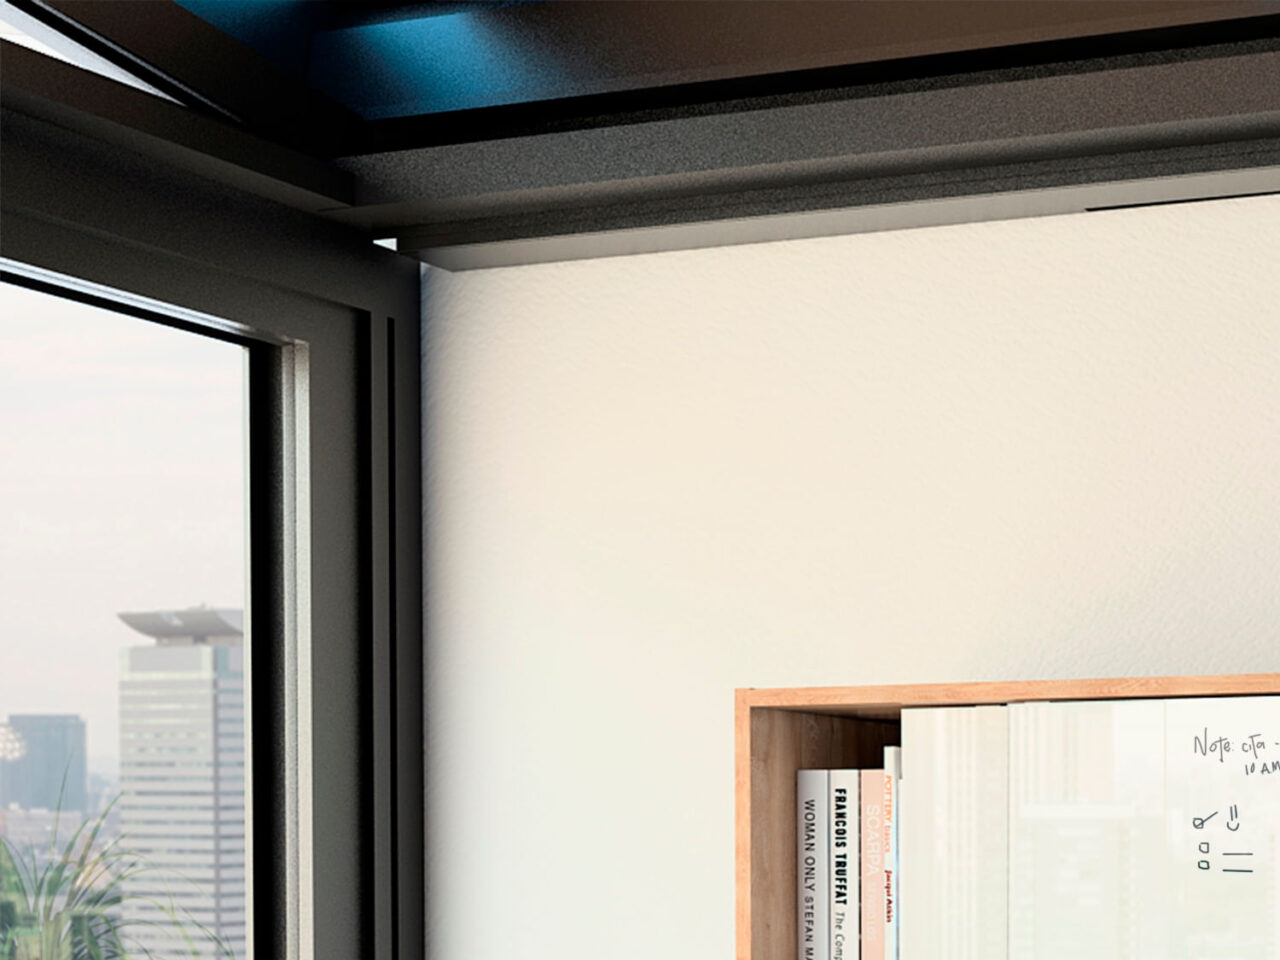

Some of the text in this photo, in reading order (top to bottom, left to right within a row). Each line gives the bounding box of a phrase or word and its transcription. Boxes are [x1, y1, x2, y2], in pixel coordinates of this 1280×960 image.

[884, 775, 893, 823] POTTERY
[803, 799, 816, 852] WOMAN
[834, 788, 847, 906] FRANCOIS TRUFFAT
[866, 804, 880, 876] SCARPA
[803, 856, 816, 892] ONLY
[804, 895, 815, 942] STEFAN
[834, 911, 846, 930] The
